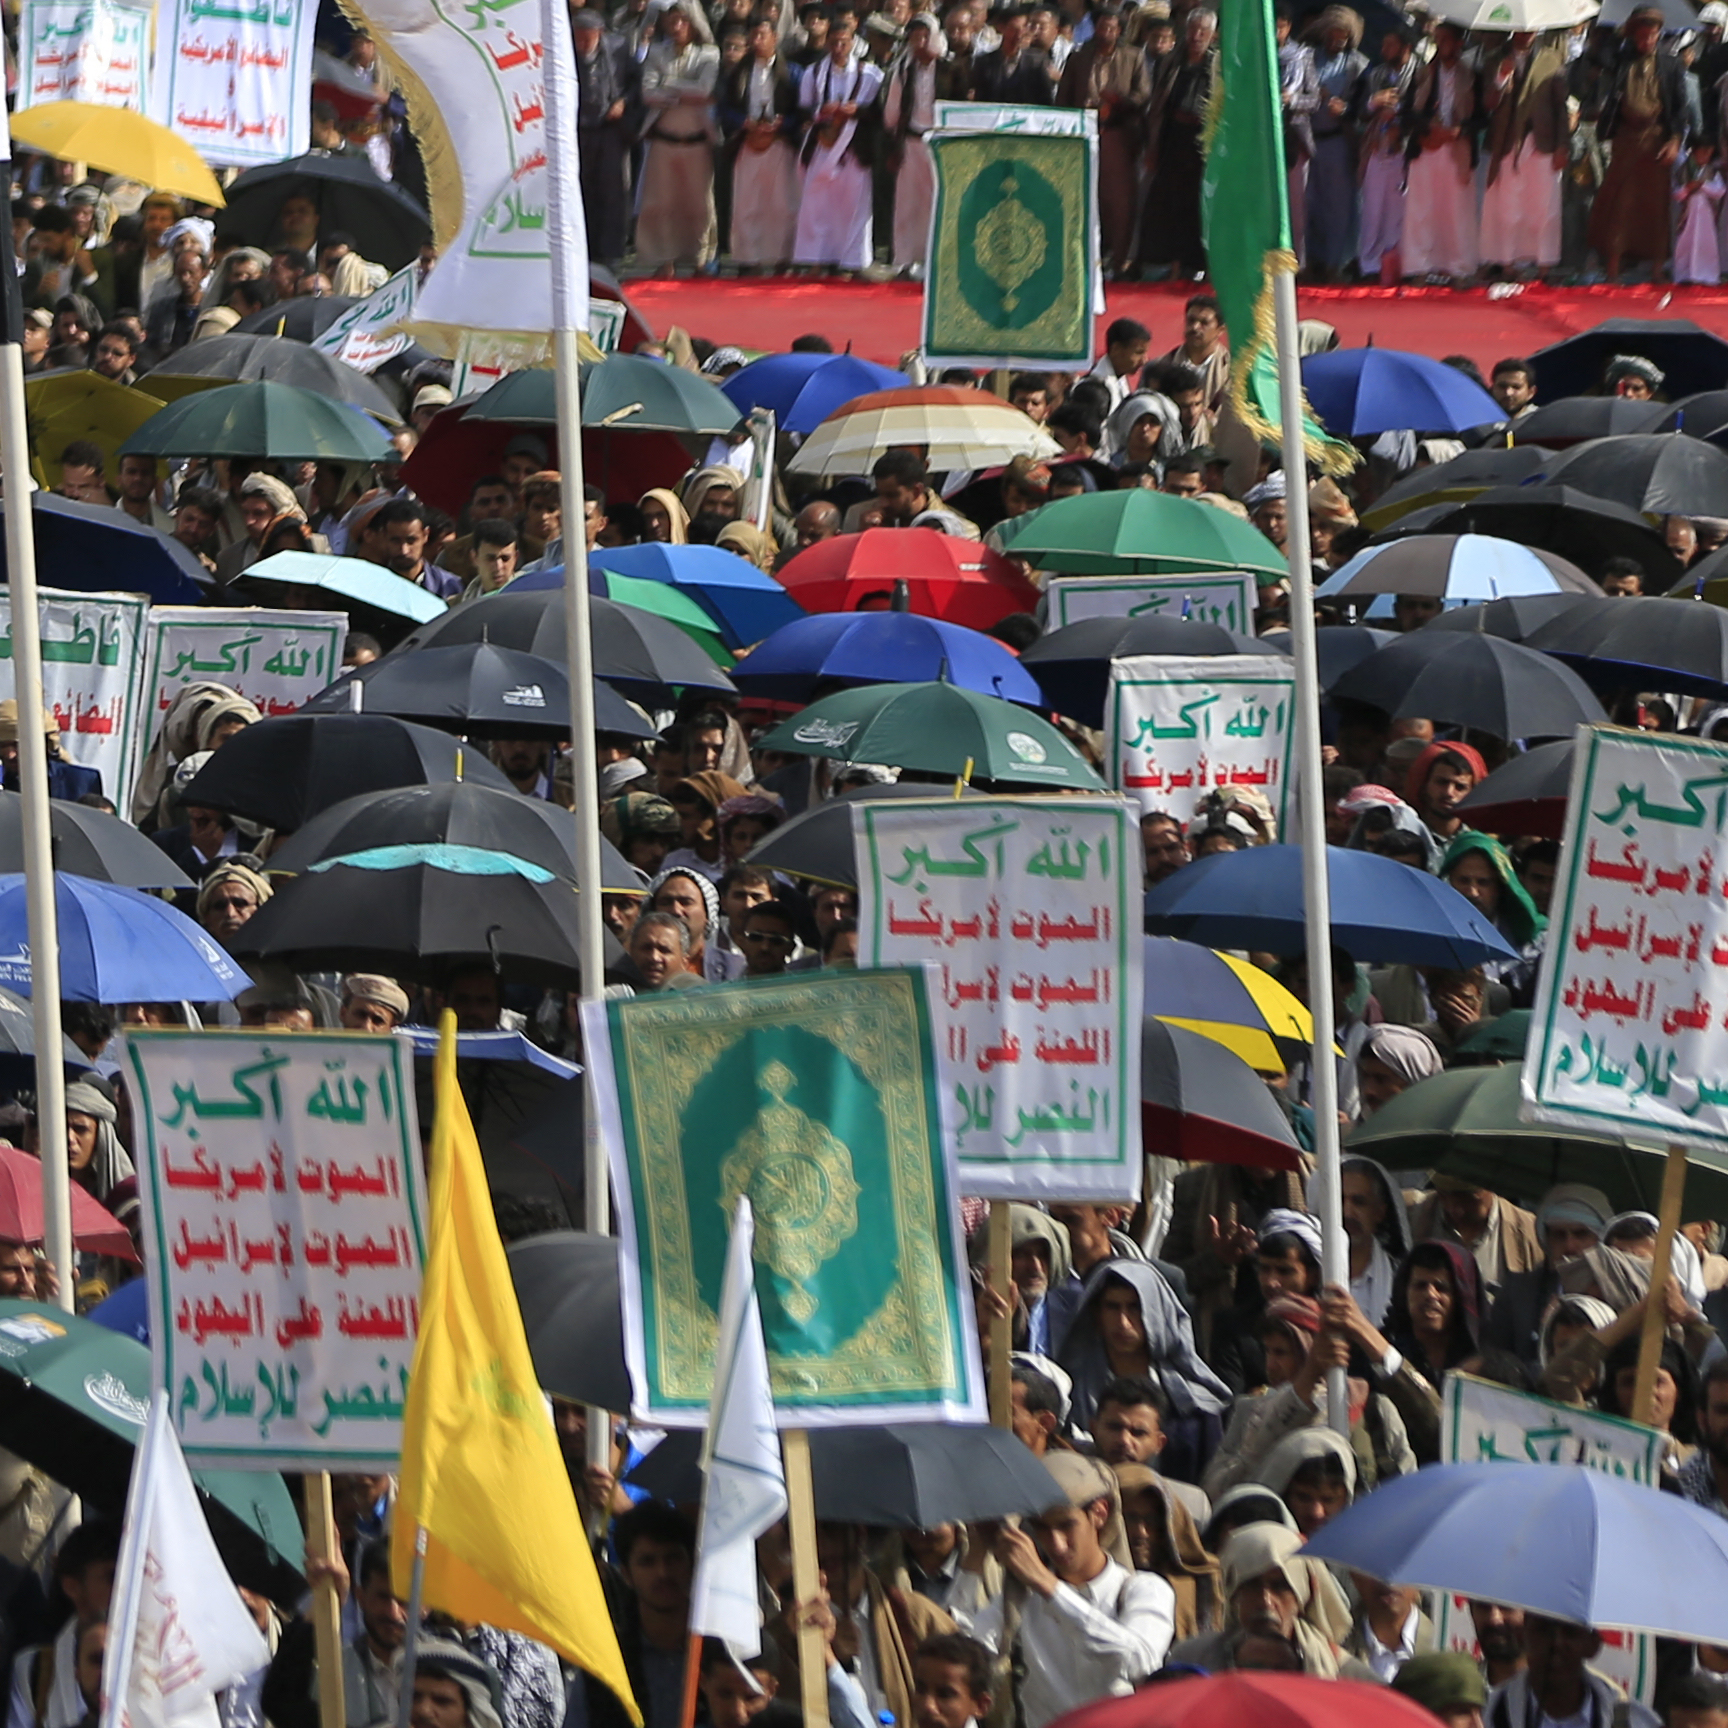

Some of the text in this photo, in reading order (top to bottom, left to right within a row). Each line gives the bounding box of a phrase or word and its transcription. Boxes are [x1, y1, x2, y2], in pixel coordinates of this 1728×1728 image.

[163, 631, 324, 682] الله أكبر
[1123, 689, 1285, 753] الله أكبر
[1215, 759, 1279, 786] الموت
[885, 812, 1110, 893] الله أكبر
[1587, 837, 1713, 896] لأمريكا
[1010, 905, 1110, 948] الموت
[1010, 969, 1110, 1011] الموت
[1564, 975, 1712, 1036] على اليهود
[976, 1029, 1020, 1072] على
[1035, 1026, 1110, 1065] اللعنة
[1552, 1030, 1677, 1109] للإسلام
[159, 1046, 393, 1140] الله أكبر
[1003, 1078, 1110, 1148] النصر
[164, 1140, 399, 1203] الموت لأمريكا
[304, 1226, 412, 1277] الموت
[178, 1291, 419, 1350] اللعنة على اليهود
[178, 1357, 300, 1441] للإسلام
